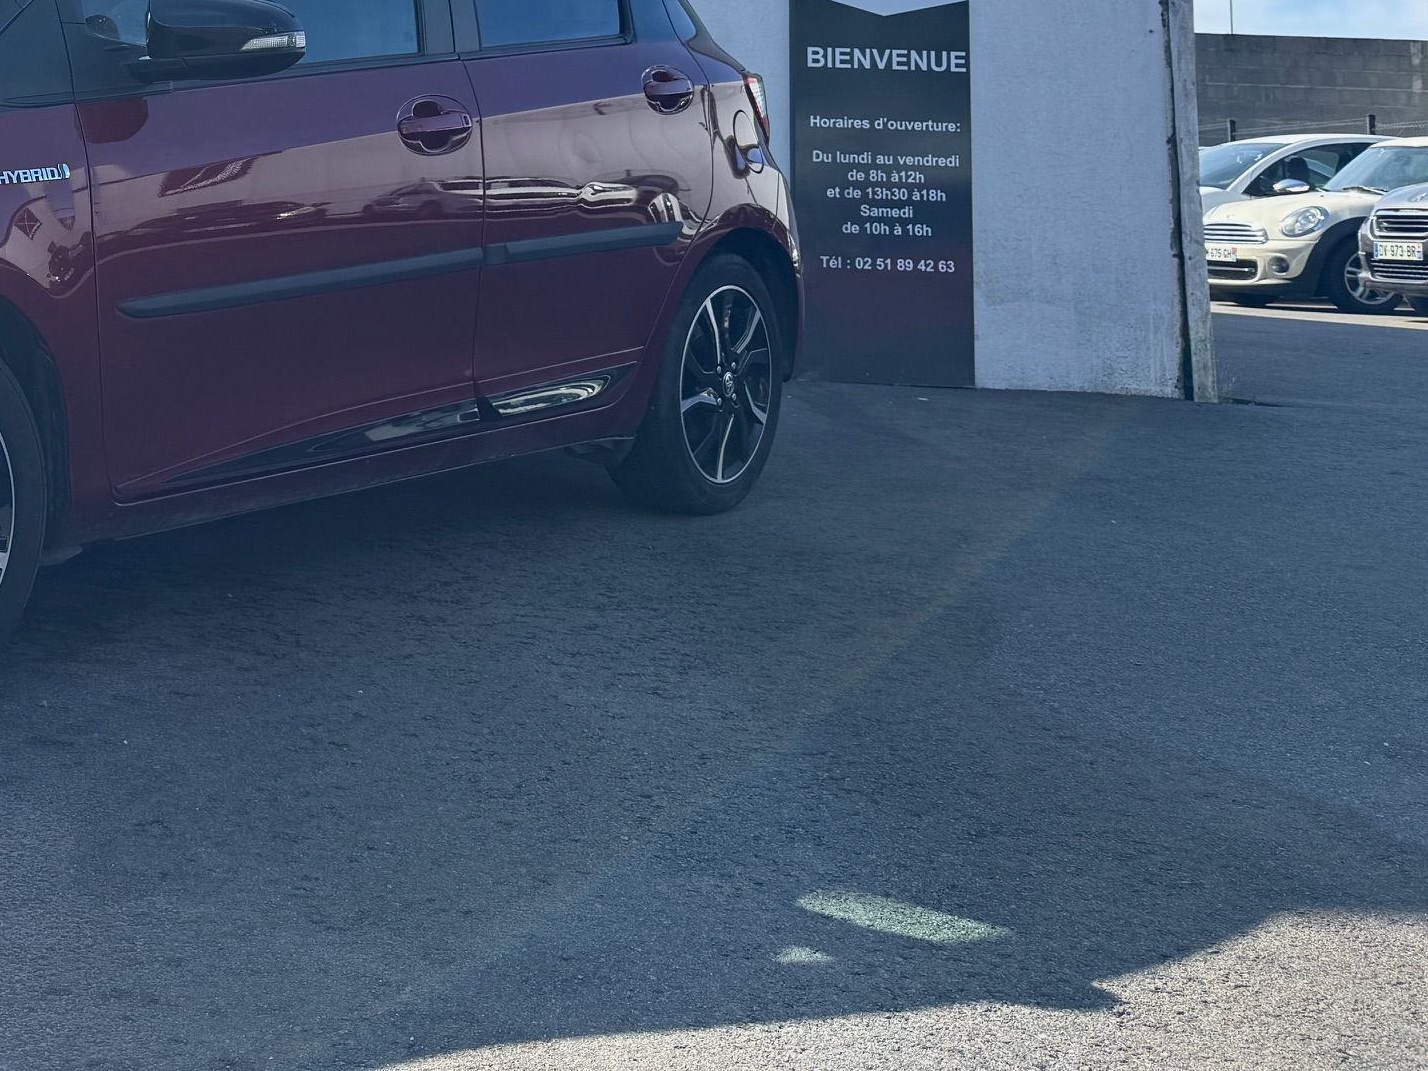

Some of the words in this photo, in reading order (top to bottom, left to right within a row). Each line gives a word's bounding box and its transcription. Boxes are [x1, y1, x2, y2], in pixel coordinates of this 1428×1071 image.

[806, 46, 968, 73] BIENVENUE
[809, 114, 870, 130] Horaires
[812, 150, 832, 163] Du
[836, 151, 872, 165] lundi
[876, 154, 893, 165] au
[897, 154, 960, 167] vendredi
[847, 169, 865, 181] de
[869, 170, 887, 182] 8h
[890, 170, 925, 184] à12h
[826, 187, 840, 198] et
[844, 186, 862, 199] de
[865, 187, 908, 200] 13h30
[912, 188, 947, 202] à18h
[859, 205, 914, 218] Samedi
[842, 222, 860, 234] de
[864, 222, 890, 235] 10h
[893, 223, 903, 236] à
[906, 224, 932, 237] 16h
[820, 255, 842, 269] Tél
[855, 257, 873, 270] 02
[876, 258, 892, 271] 51
[896, 258, 914, 272] 89
[917, 259, 935, 272] 42
[938, 260, 955, 273] 63
